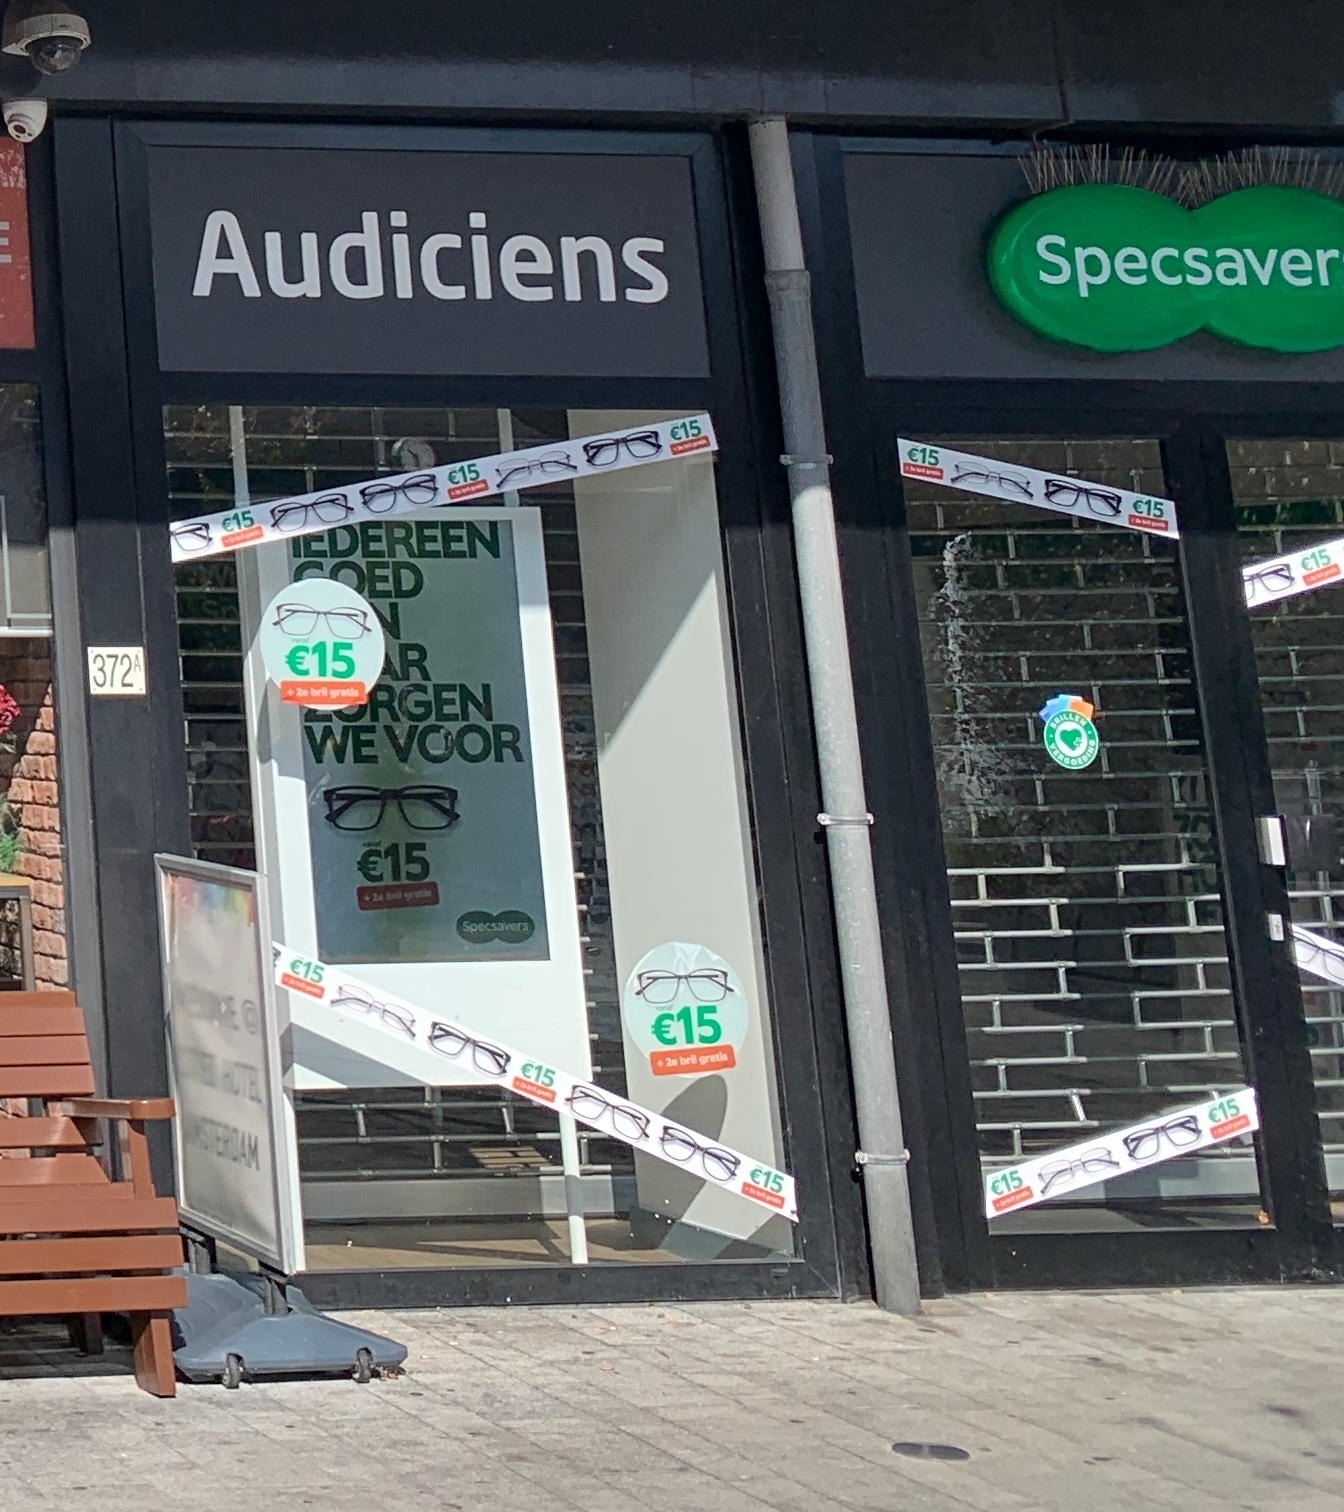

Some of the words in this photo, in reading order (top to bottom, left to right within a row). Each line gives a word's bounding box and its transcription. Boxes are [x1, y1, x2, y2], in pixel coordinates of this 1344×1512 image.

[192, 209, 670, 304] Audiciens
[1035, 234, 1344, 298] Specsaver
[670, 420, 701, 441] €15
[906, 447, 940, 466] €15
[447, 463, 480, 485] €15
[221, 509, 255, 533] €15
[1132, 499, 1164, 518] €15
[291, 520, 501, 559] IEDEREEN
[1300, 548, 1332, 571] €15
[285, 640, 356, 679] €15
[310, 687, 328, 697] bril
[329, 687, 360, 700] gratis
[303, 724, 379, 765] WE
[383, 723, 526, 765] VOOR
[356, 842, 431, 883] €15
[462, 919, 529, 934] Specsavers
[290, 959, 325, 984] €15
[650, 1004, 722, 1046] €15
[679, 1054, 697, 1065] bril
[698, 1051, 729, 1066] gratis
[520, 1062, 556, 1087] €15
[1208, 1098, 1240, 1124] €15
[185, 1114, 261, 1172] STERDAM
[750, 1168, 785, 1194] €15
[990, 1169, 1023, 1196] €15
